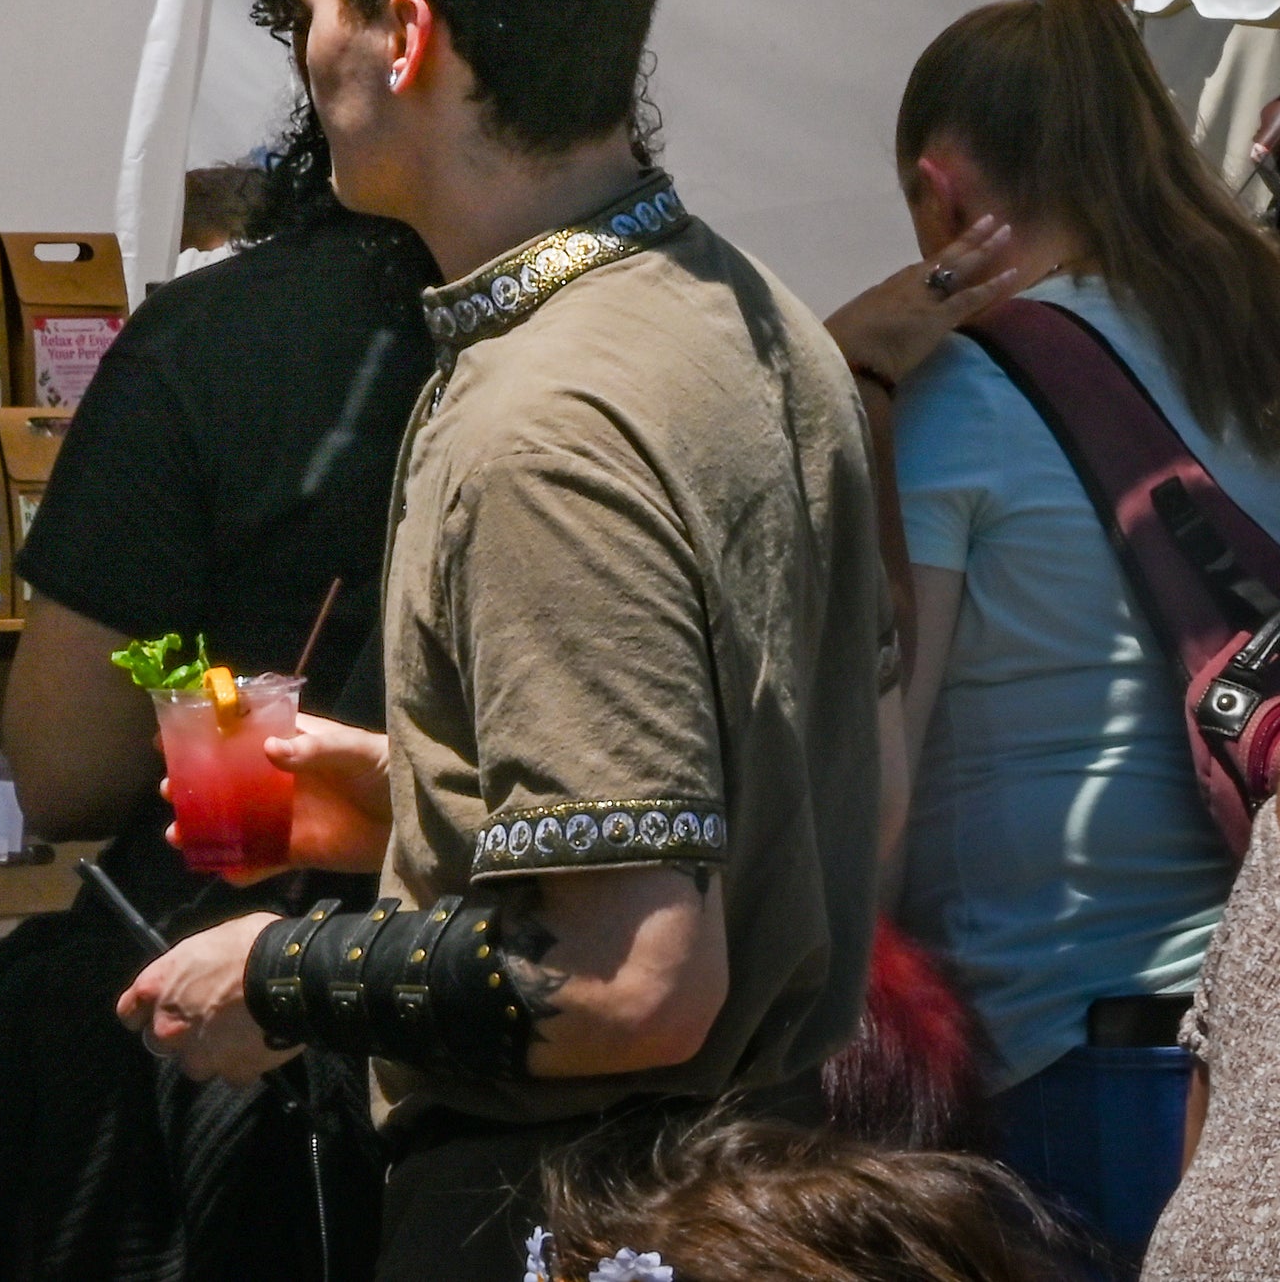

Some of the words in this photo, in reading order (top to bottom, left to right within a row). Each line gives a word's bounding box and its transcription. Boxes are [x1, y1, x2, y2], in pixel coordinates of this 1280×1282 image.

[41, 335, 72, 346] Relax
[89, 335, 113, 348] Enjo
[48, 348, 75, 359] Your
[78, 348, 102, 359] Peri
